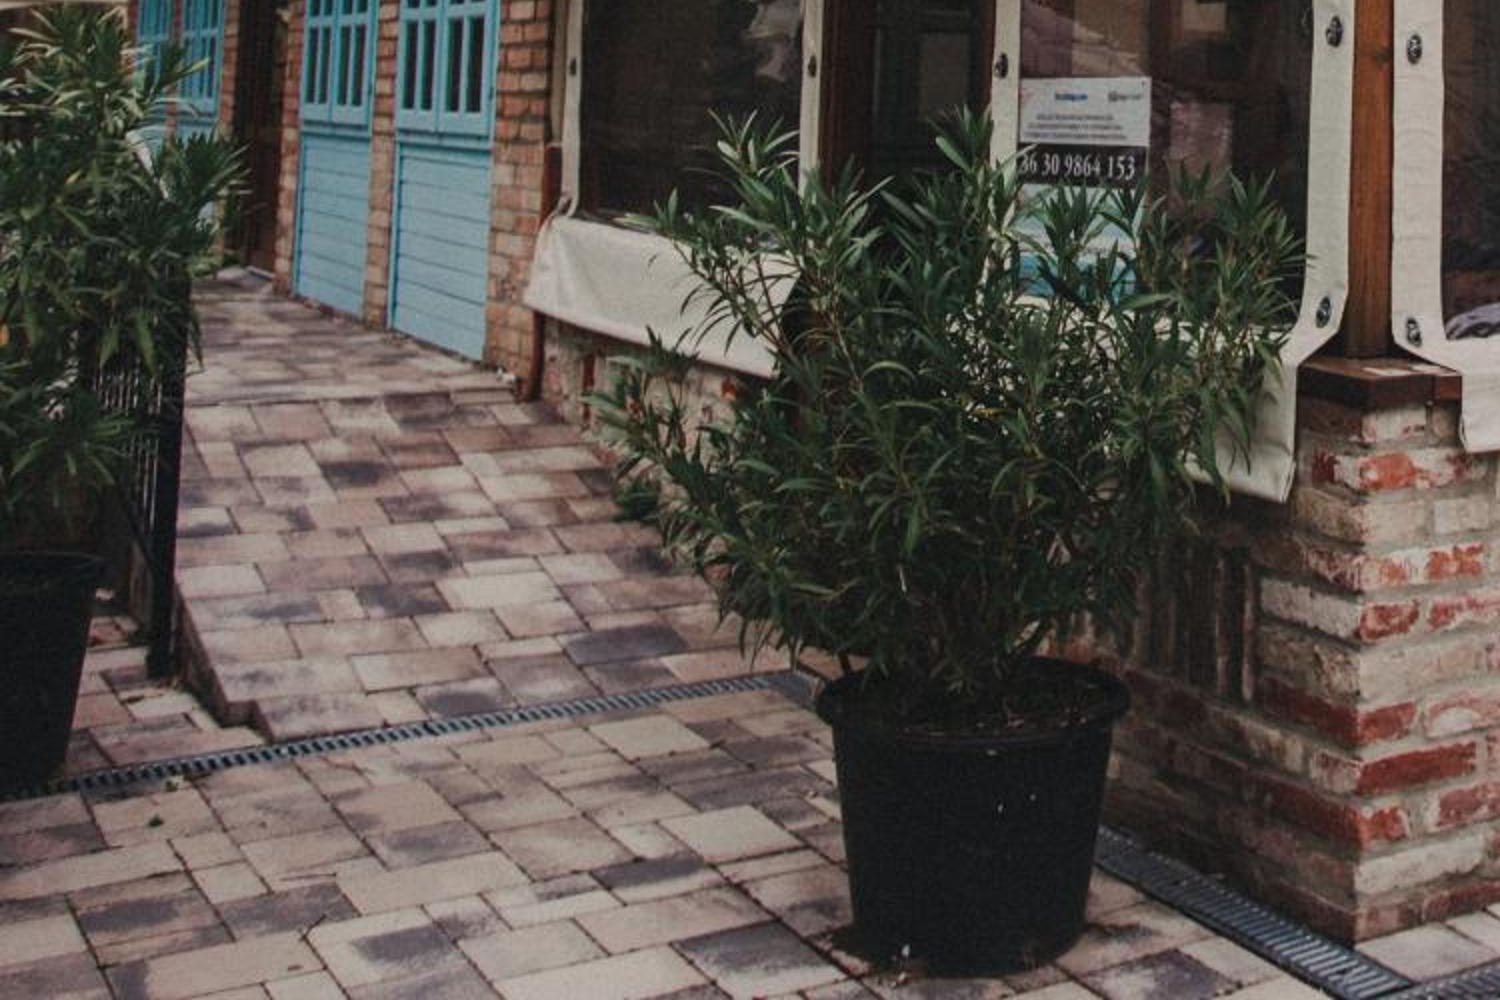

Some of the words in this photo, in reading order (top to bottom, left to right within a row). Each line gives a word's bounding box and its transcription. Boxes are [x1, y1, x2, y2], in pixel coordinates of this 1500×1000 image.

[1041, 153, 1060, 176] 30
[1063, 153, 1101, 178] 9864
[1107, 155, 1136, 181] 153
